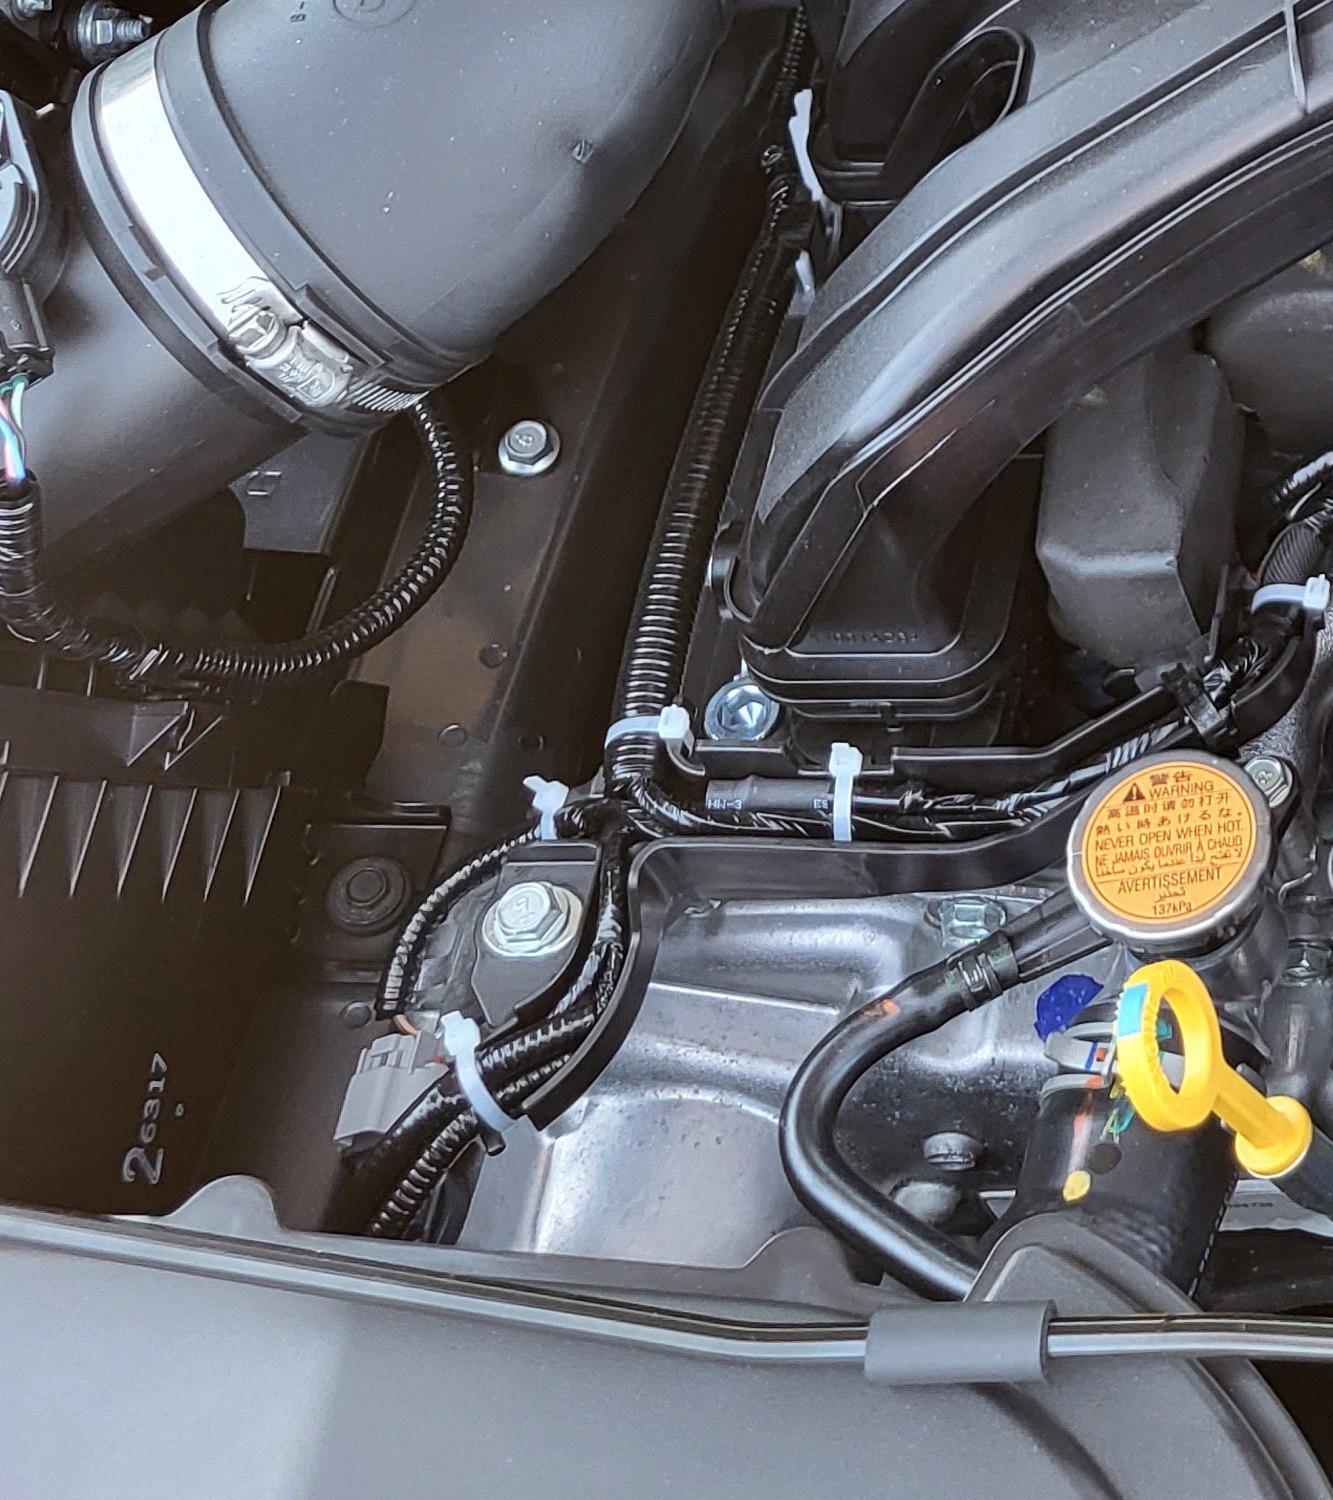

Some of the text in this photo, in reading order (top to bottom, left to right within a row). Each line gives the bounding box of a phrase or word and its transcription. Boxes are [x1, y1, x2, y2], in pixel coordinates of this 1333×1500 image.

[1149, 780, 1215, 799] WARNING
[1107, 791, 1230, 820] 高温时请勿打开
[1095, 834, 1135, 852] NEVER
[1139, 829, 1172, 847] OPEN
[1176, 822, 1213, 841] WHEN
[1095, 854, 1109, 868] NE
[1113, 848, 1150, 868] JAMAIS
[1154, 841, 1193, 859] OUVRIR
[1207, 835, 1243, 852] CHAUD
[1118, 866, 1223, 895] AVERTISSEMENT
[1151, 900, 1193, 916] 137kPa
